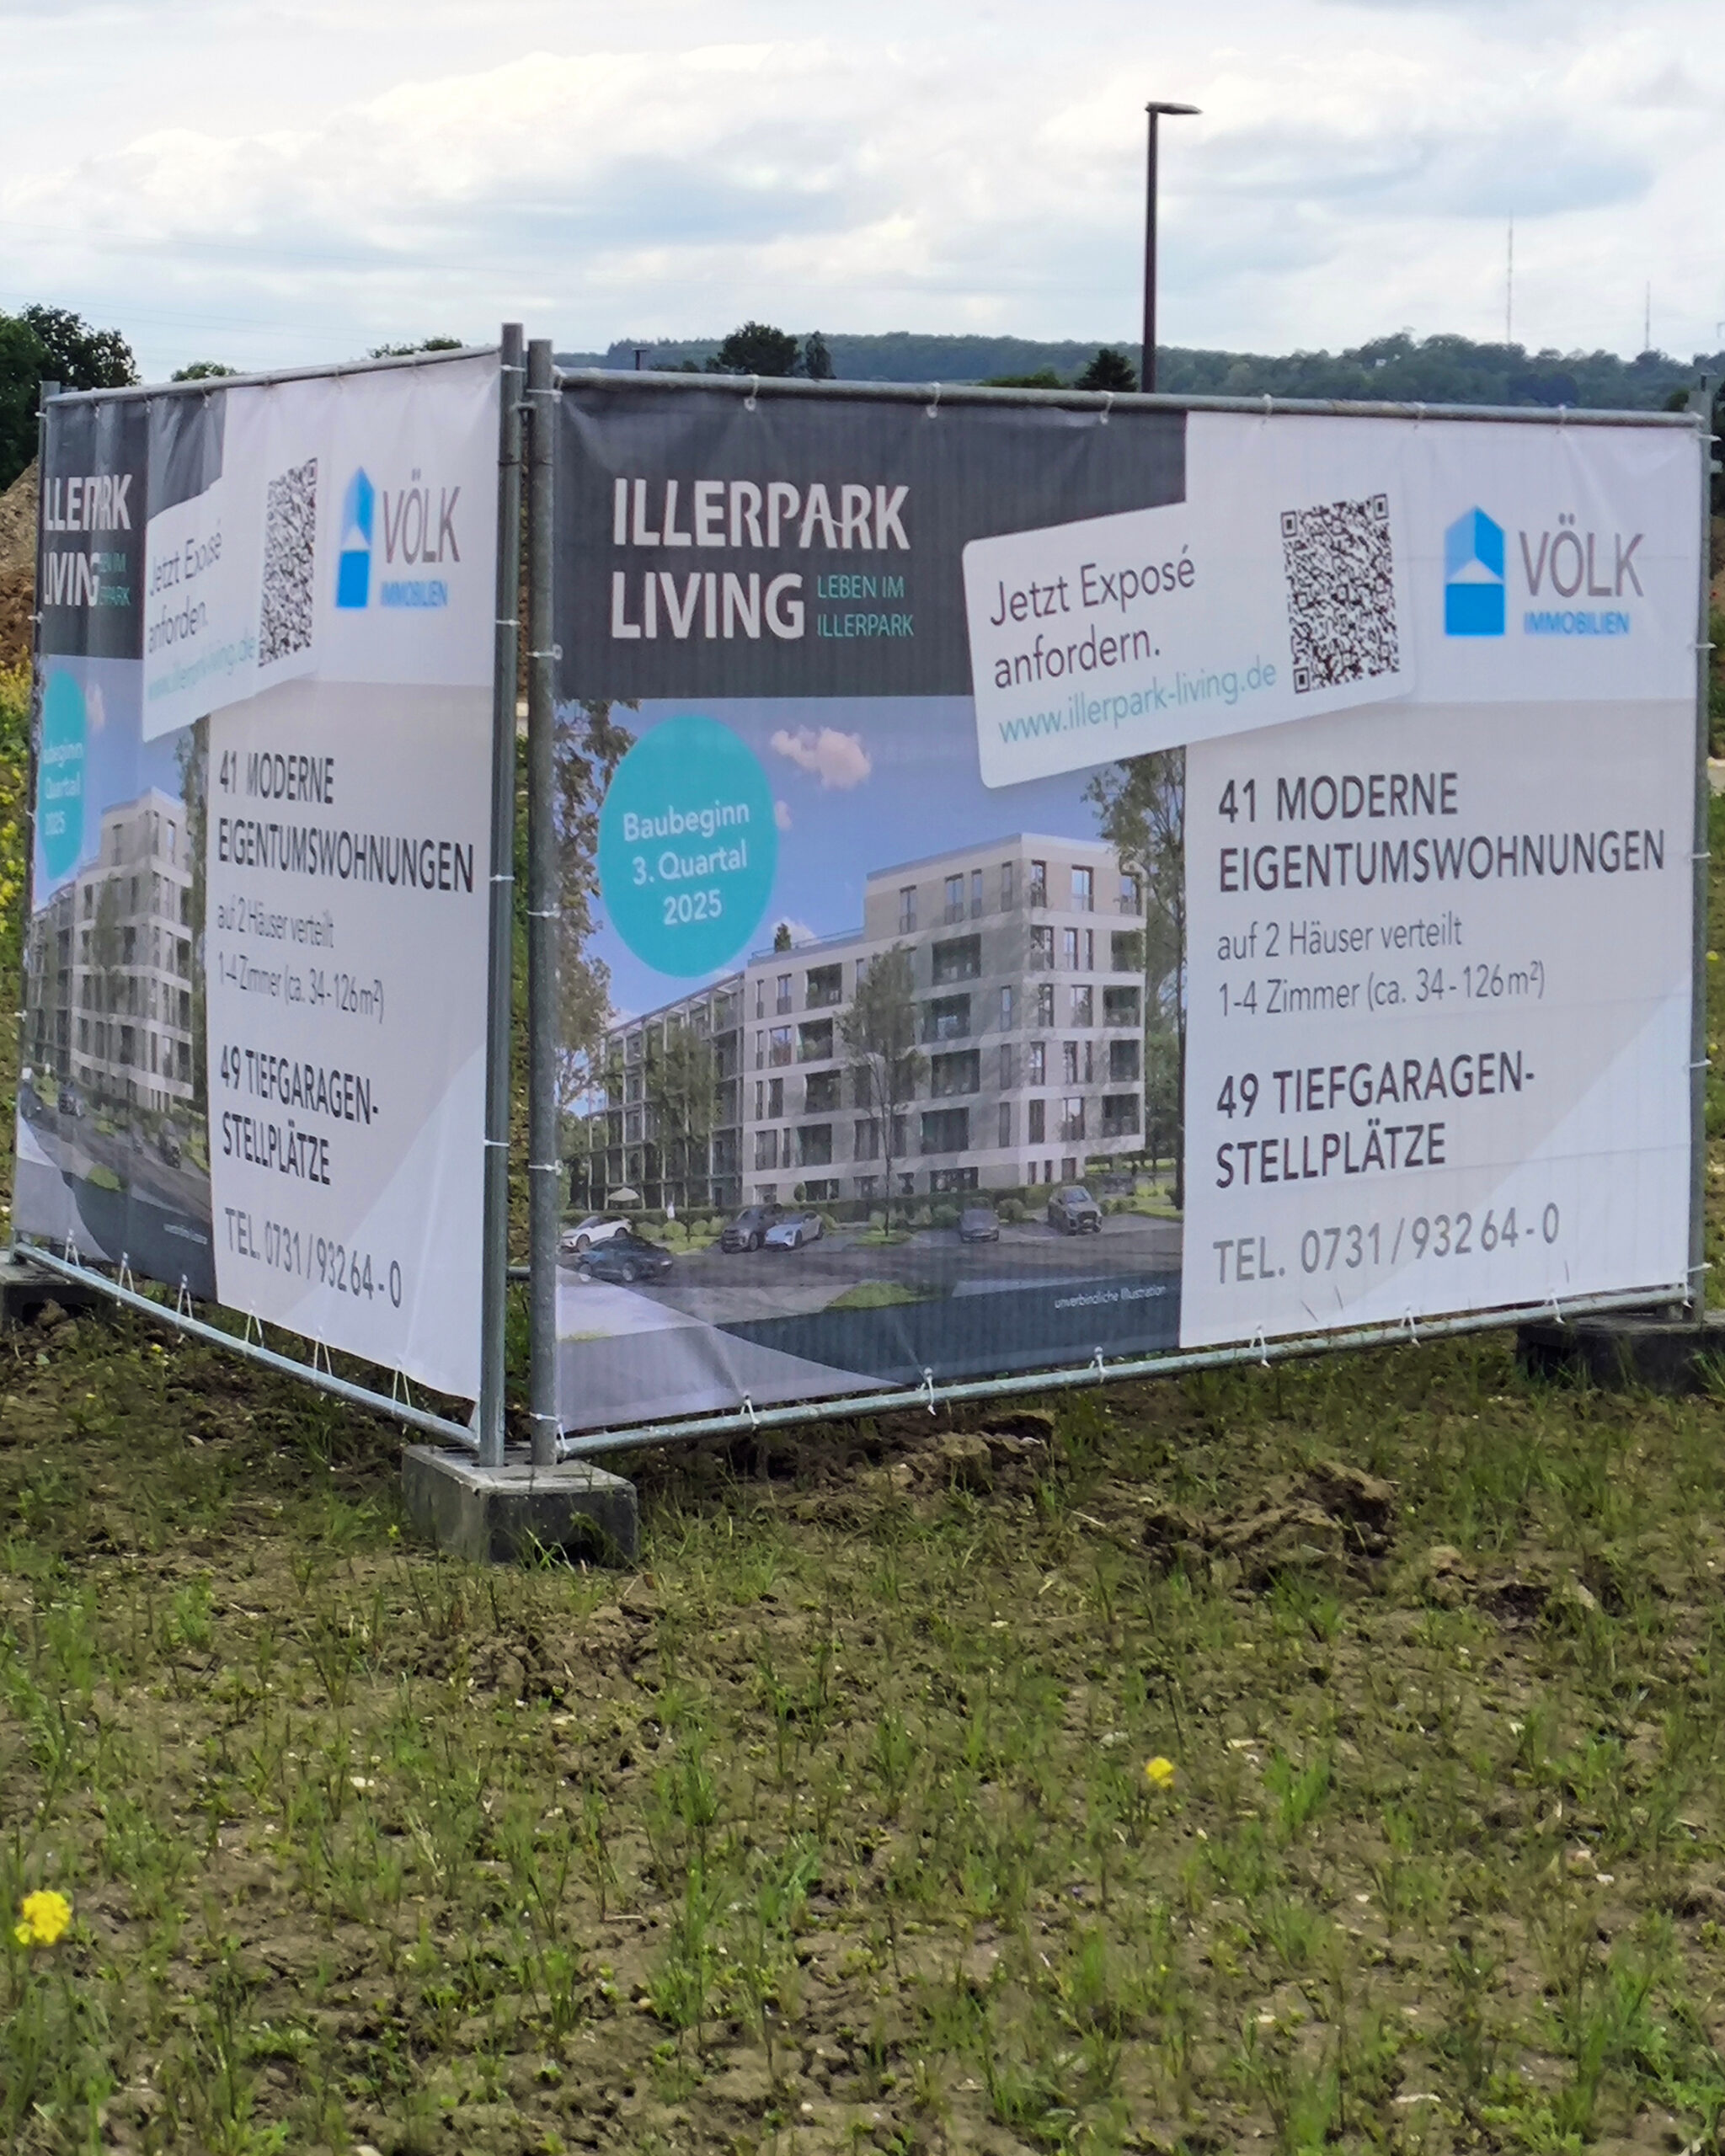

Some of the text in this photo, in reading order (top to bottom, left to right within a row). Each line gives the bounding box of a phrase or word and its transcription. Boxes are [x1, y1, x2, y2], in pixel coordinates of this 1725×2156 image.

[383, 468, 461, 566] VÖLK
[614, 478, 911, 550] ILLERPARK
[817, 574, 905, 599] LEBEN IM
[991, 545, 1195, 627] Jetzt Exposé
[1519, 512, 1645, 598] VÖLK
[611, 571, 805, 640] LIVING
[816, 613, 915, 638] ILLERPARK
[995, 624, 1161, 688] anfordern.
[998, 654, 1277, 744] www.illerpark-living.de
[220, 750, 334, 804] 41 MODERNE
[1218, 771, 1459, 823] 41 MODERNE
[623, 799, 750, 842] Baubeginn
[219, 817, 473, 894] EIGENTUMSWOHNUNGEN
[633, 838, 748, 885] 3. Quartal
[1220, 830, 1665, 893] EIGENTUMSWOHNUNGEN
[664, 889, 723, 925] 2025
[1217, 910, 1462, 961] auf 2 Häuser verteilt
[1267, 977, 1360, 1015] Zimmer
[1367, 971, 1407, 1013] (ca.
[221, 1044, 379, 1125] 49 TIEFGARAGEN-
[1216, 1050, 1535, 1119] 49 TIEFGARAGEN-
[223, 1111, 330, 1185] STELLPLÄTZE
[1215, 1118, 1446, 1188] STELLPLÄTZE
[1213, 1235, 1285, 1284] TEL.
